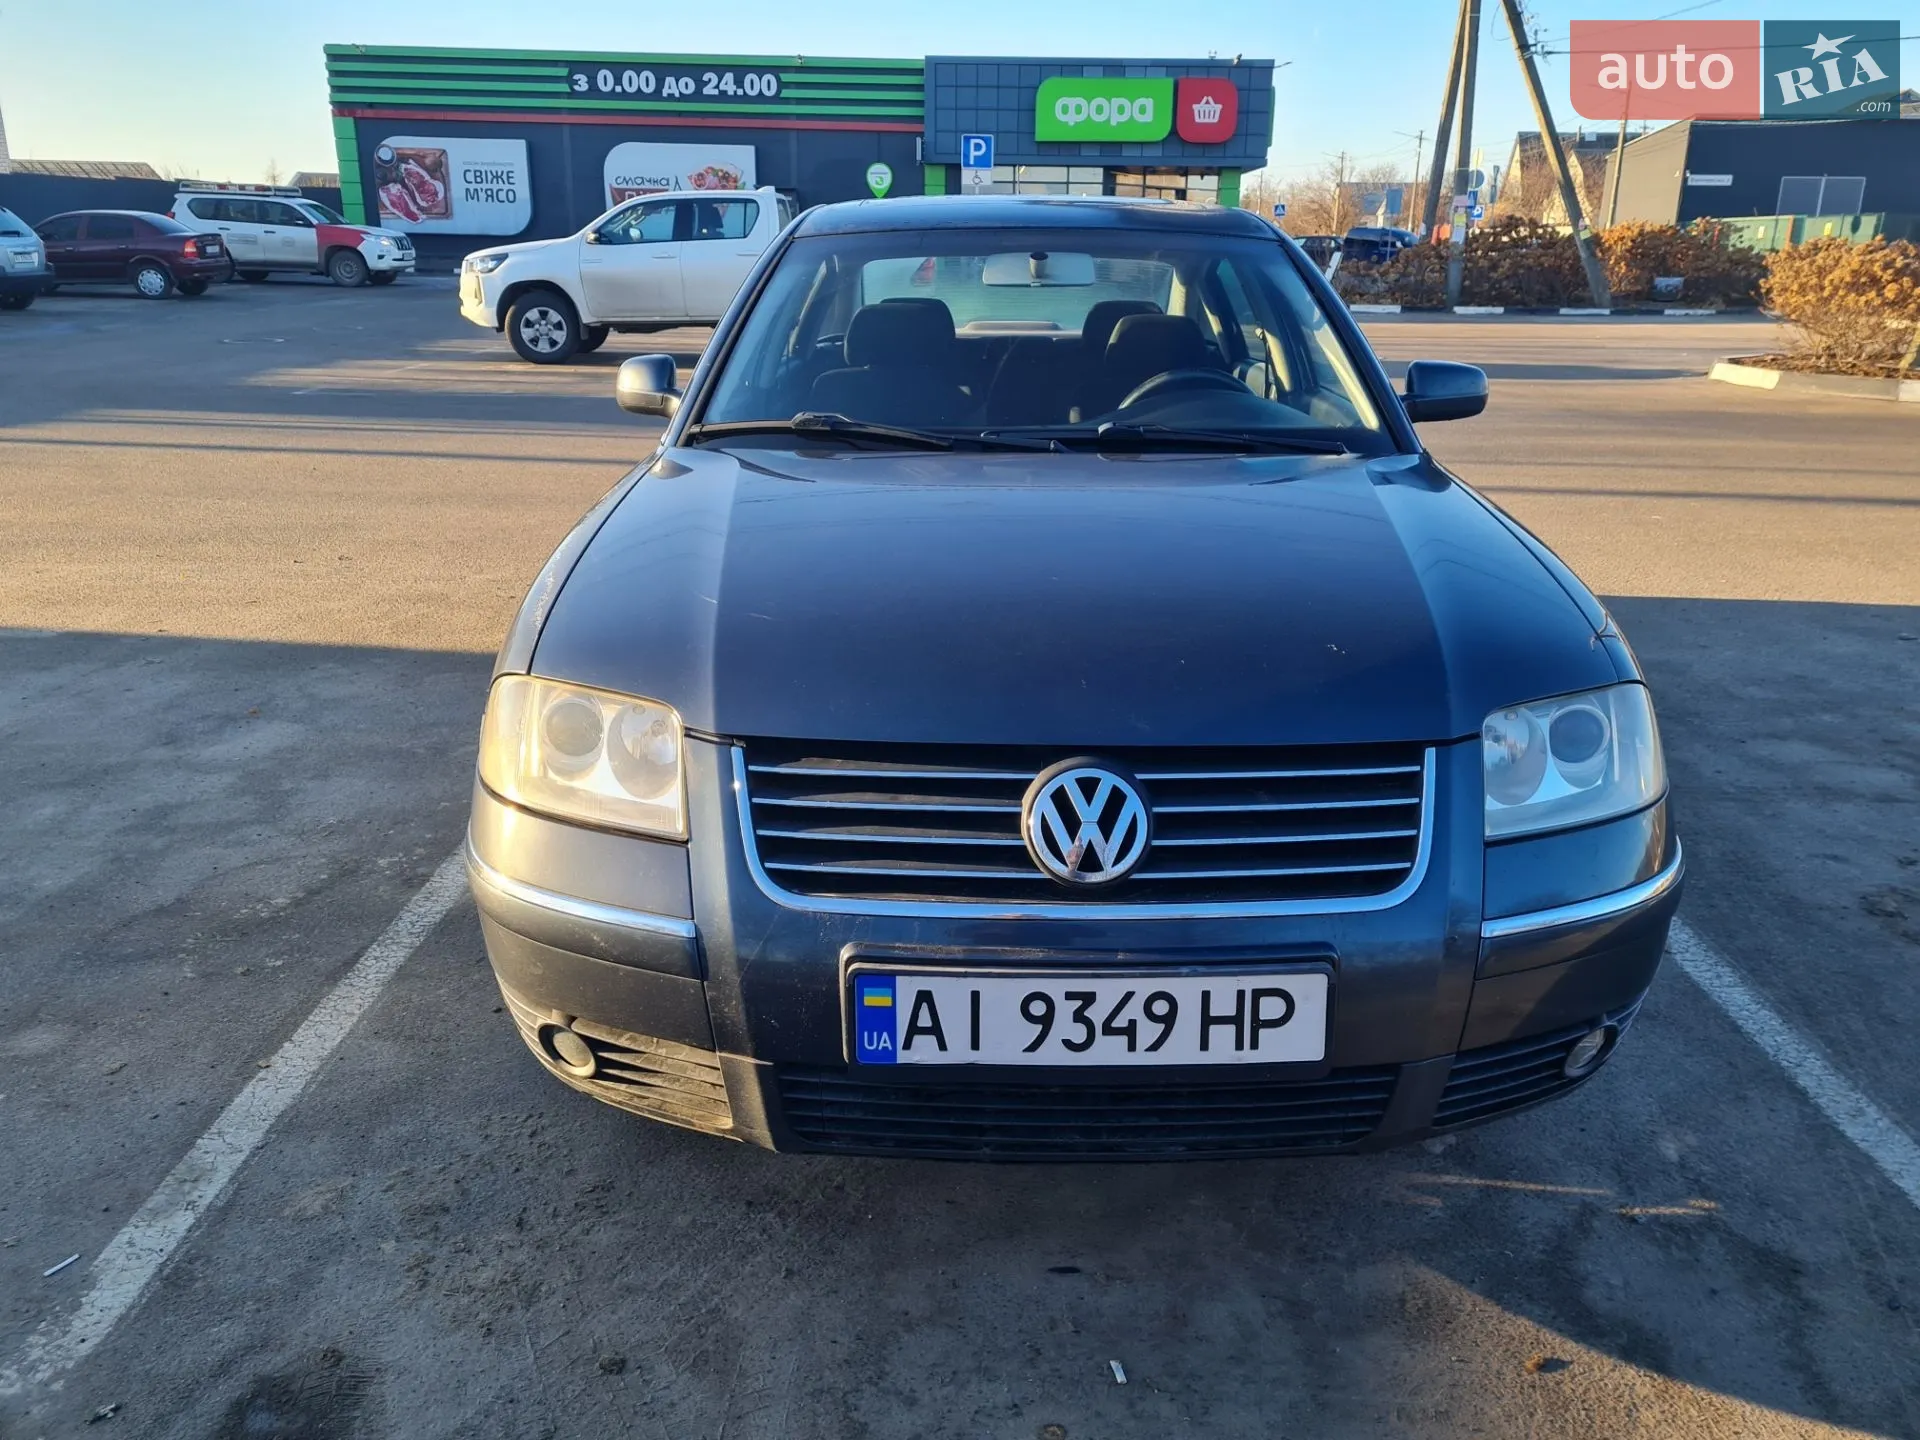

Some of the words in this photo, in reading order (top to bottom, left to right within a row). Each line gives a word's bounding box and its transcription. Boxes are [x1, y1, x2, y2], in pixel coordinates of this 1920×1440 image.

[597, 69, 656, 93] 0.00
[662, 76, 695, 97] до
[702, 72, 778, 97] 24.00
[463, 169, 516, 185] СВІЖЕ
[902, 989, 981, 1052] AI
[1020, 990, 1179, 1053] 9349
[1200, 988, 1296, 1052] HP
[864, 1032, 893, 1052] UA
